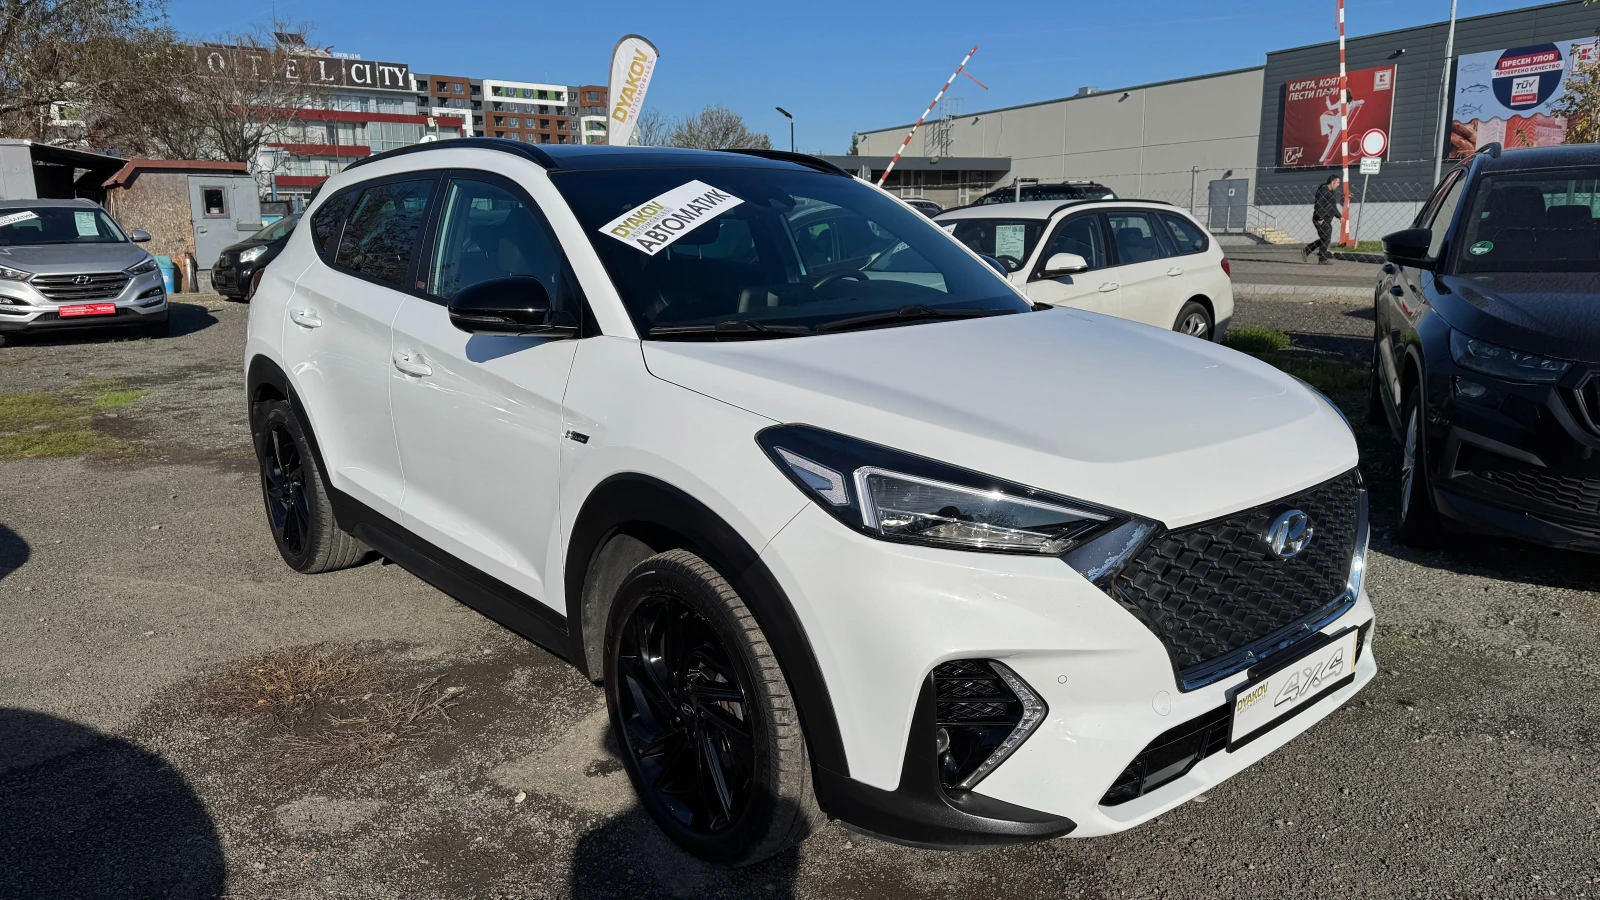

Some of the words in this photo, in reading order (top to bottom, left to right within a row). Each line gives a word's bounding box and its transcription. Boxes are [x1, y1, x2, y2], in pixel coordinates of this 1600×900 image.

[351, 63, 407, 86] CITY
[1495, 68, 1530, 77] ПРОВЕРЕНО
[1530, 63, 1561, 72] КАЧЕСТВО
[1501, 57, 1531, 68] ПРЕСЕН
[1532, 53, 1555, 64] УЛОВ
[611, 47, 649, 124] DYAKOV
[628, 59, 653, 120] AUTOMOBILES
[1288, 90, 1315, 101] ПЕСТИ
[1289, 80, 1317, 92] КАРТА,
[610, 200, 665, 239] DYAKOV
[631, 209, 671, 238] AUTOMOBILES
[636, 188, 731, 253] АВТОМАТИК
[1236, 681, 1269, 712] DYAKOV
